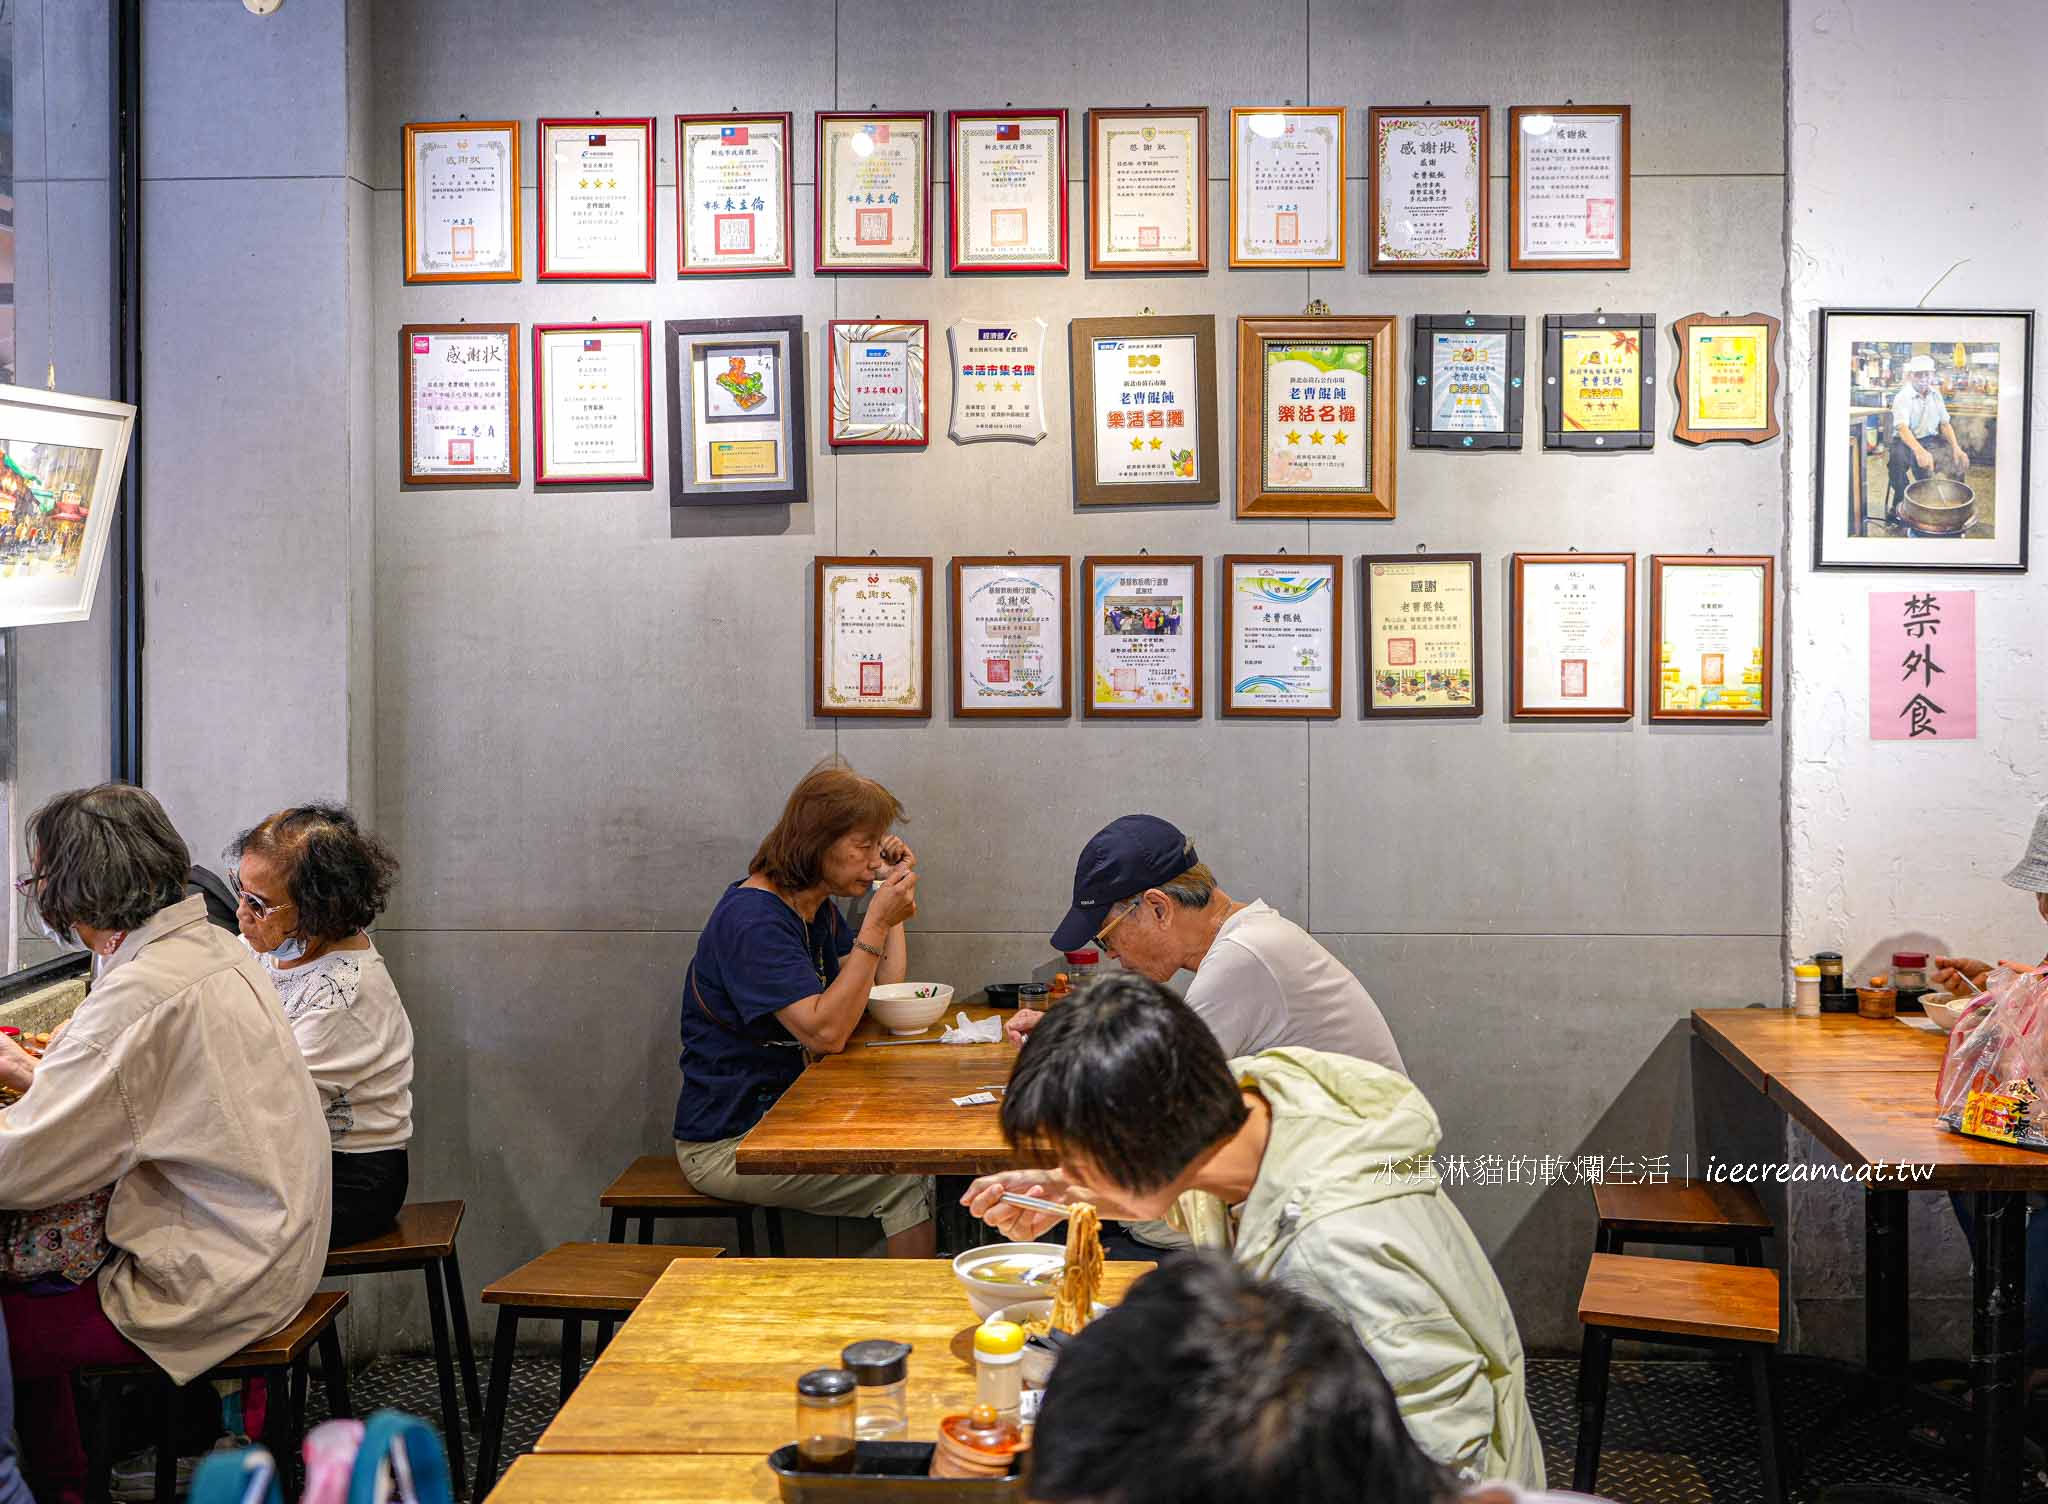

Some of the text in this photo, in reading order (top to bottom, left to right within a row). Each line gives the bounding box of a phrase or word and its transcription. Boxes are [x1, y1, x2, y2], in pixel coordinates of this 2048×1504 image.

[1400, 141, 1458, 155] 感謝狀
[723, 196, 765, 211] 朱立倫
[962, 364, 1036, 376] 樂活市集名攤
[1120, 391, 1175, 405] 老曹餛飩
[1289, 387, 1347, 400] 老曹餛飩
[1107, 409, 1185, 429] 樂活名攤
[1279, 405, 1356, 422] 樂活名攤
[1410, 580, 1437, 593] 感謝
[996, 595, 1030, 606] 感謝狀
[1400, 601, 1446, 613] 老曹餛飩
[1263, 613, 1302, 623] 老曹餛飩
[1899, 594, 1945, 738] 禁外食
